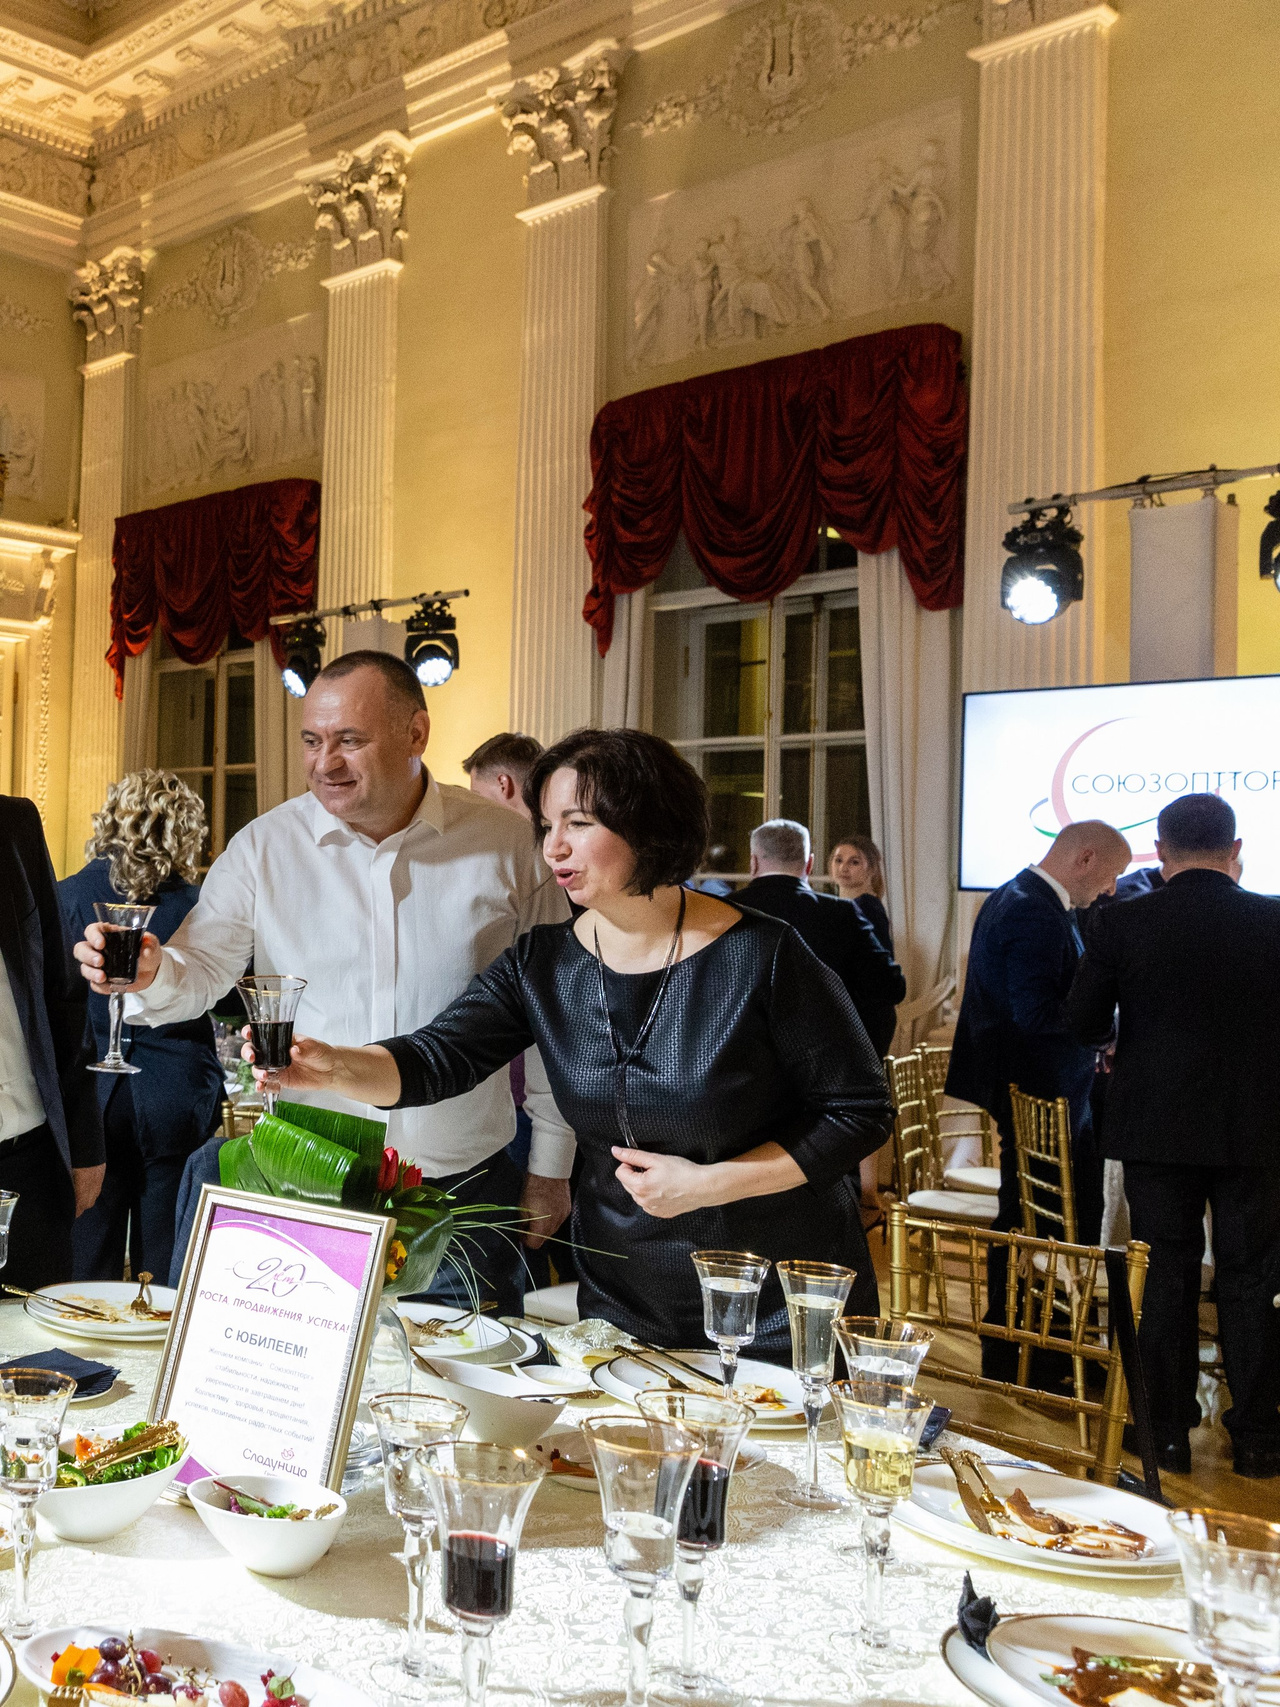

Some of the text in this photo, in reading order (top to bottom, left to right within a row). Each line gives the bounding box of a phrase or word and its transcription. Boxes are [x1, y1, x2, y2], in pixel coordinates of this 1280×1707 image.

[245, 1257, 306, 1298] 20
[306, 1315, 350, 1333] УСПЕХА!
[224, 1327, 309, 1359] С ЮБИЛЕЕМ!
[194, 1387, 230, 1404] Коллективу
[204, 1376, 244, 1392] уверенности
[250, 1389, 290, 1405] завтрашнем
[210, 1407, 248, 1424] позитивных
[248, 1418, 283, 1434] радостных
[283, 1429, 315, 1443] событий!
[242, 1448, 308, 1478] Сладуница
